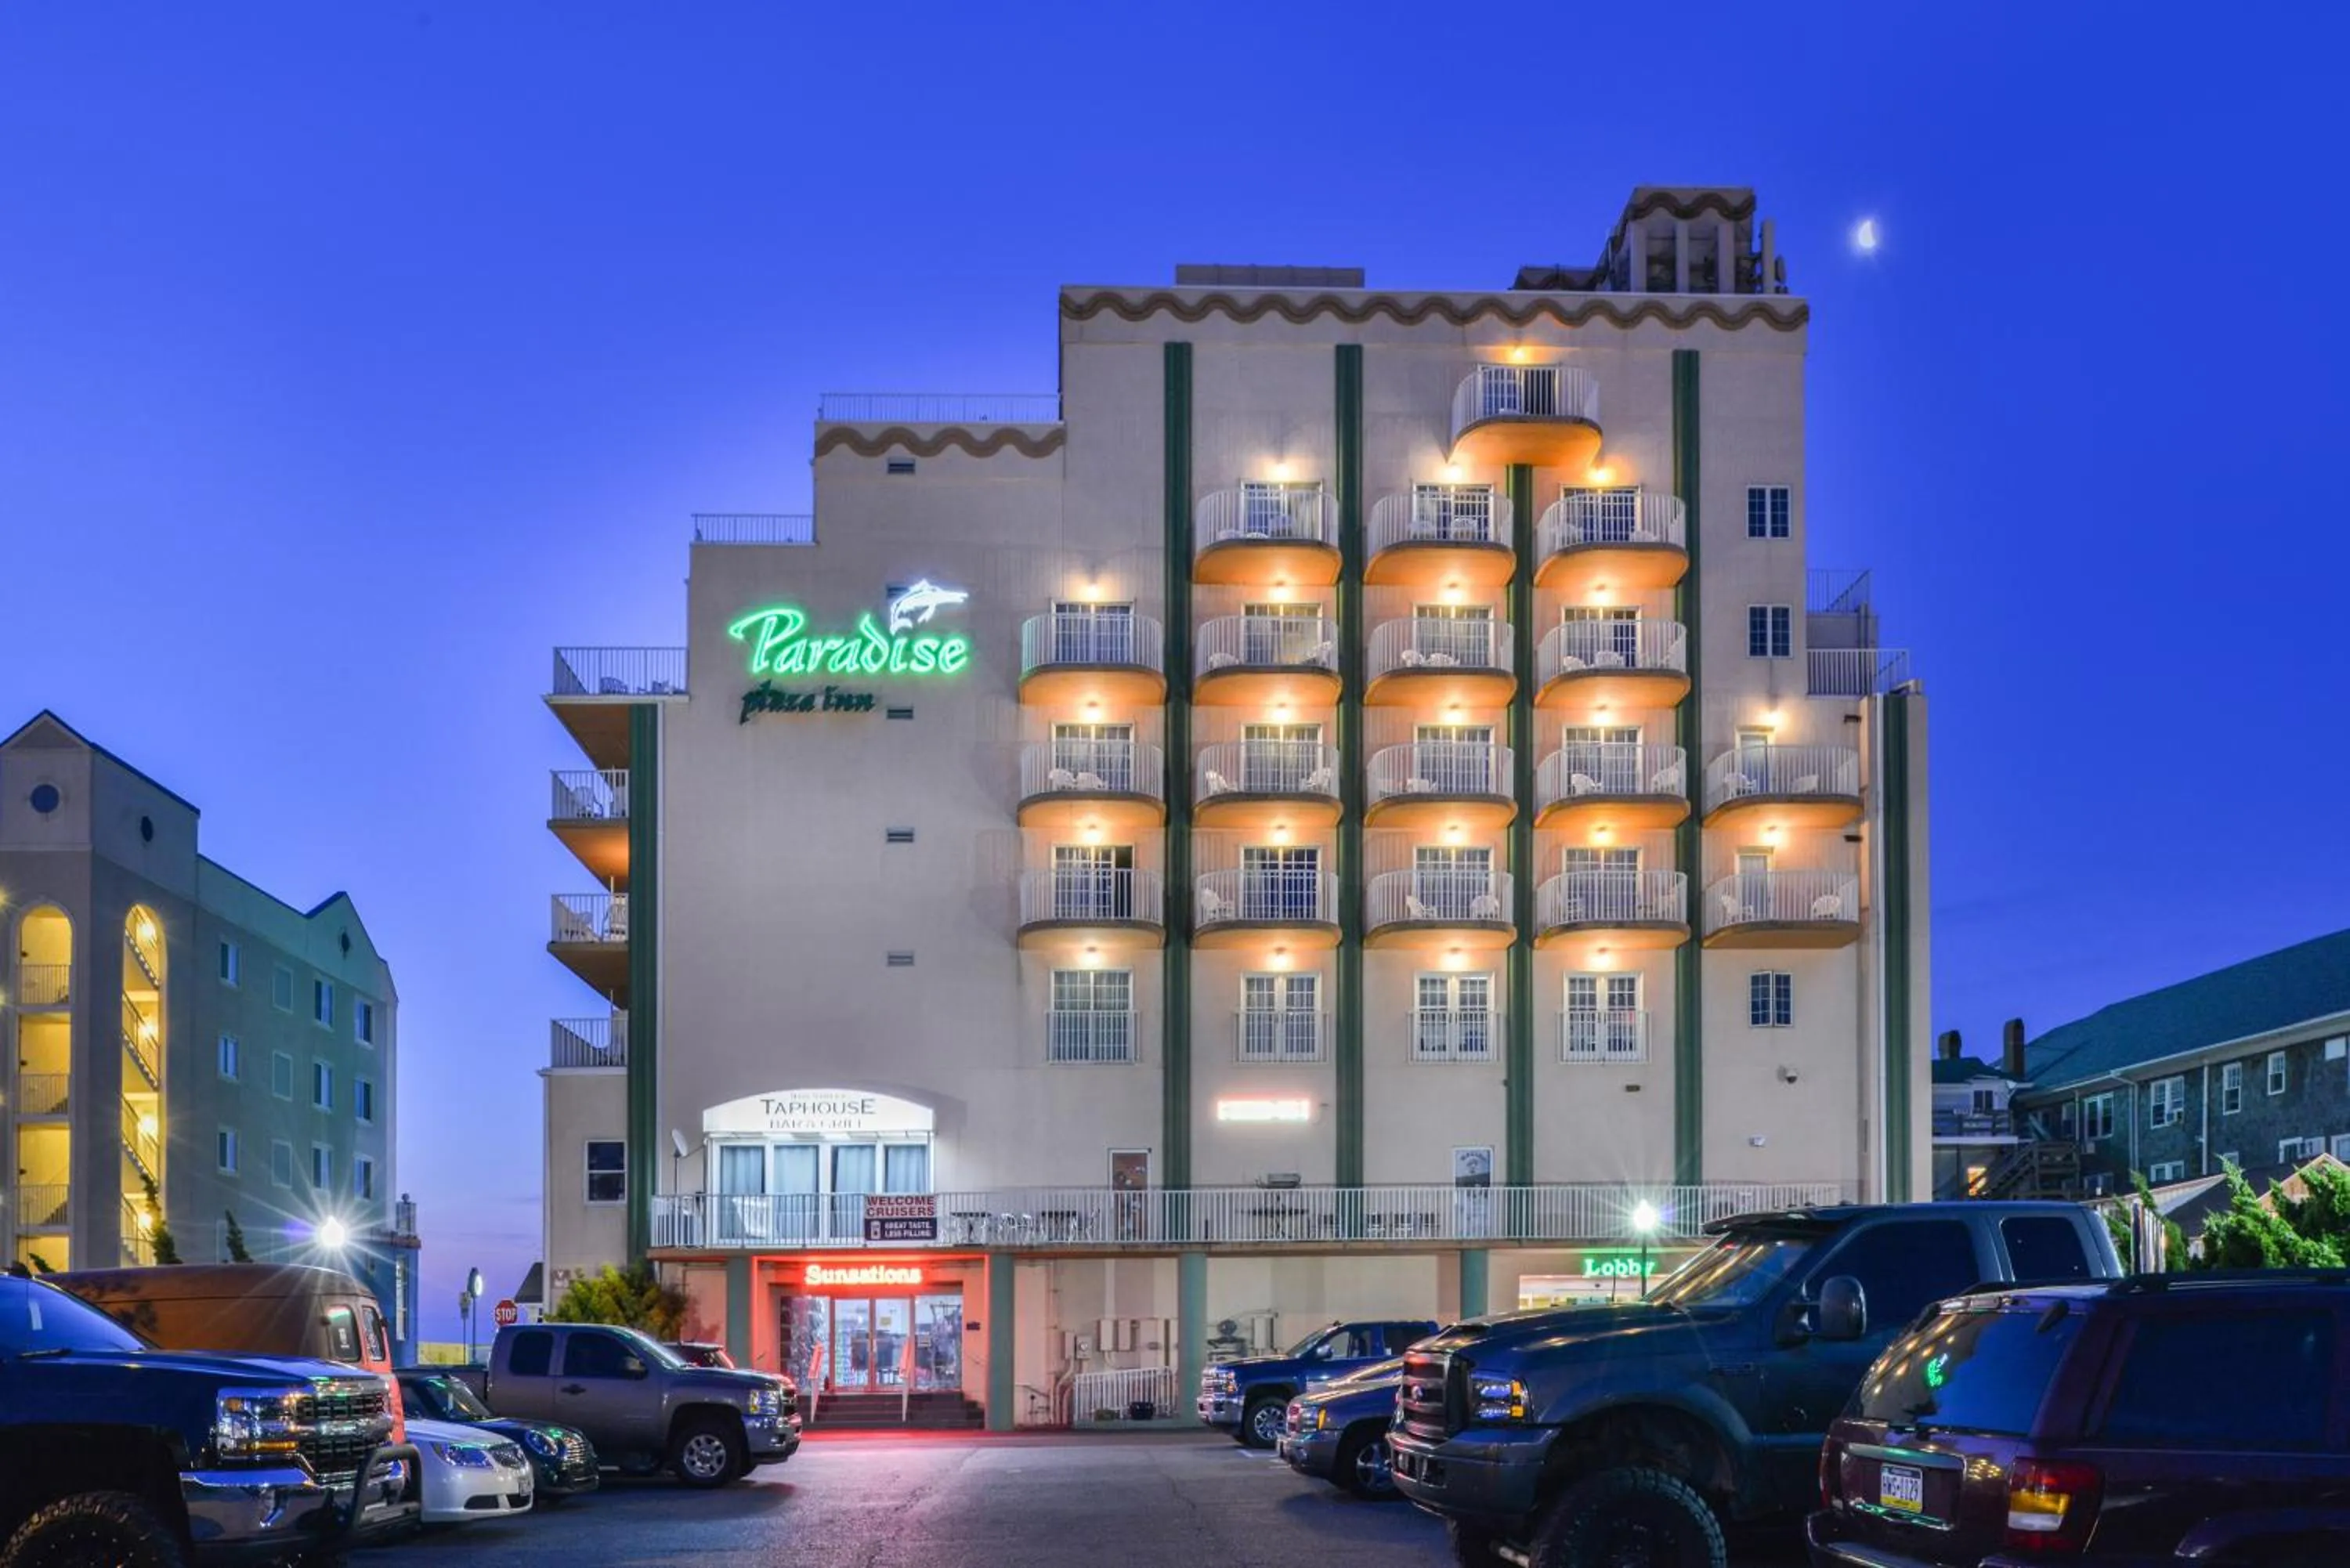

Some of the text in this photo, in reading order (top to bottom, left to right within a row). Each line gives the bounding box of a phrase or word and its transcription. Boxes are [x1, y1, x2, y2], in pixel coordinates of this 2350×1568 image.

[728, 608, 968, 672] Paradise
[760, 1098, 876, 1115] TAPHOUSE
[867, 1196, 934, 1205] WELCOME
[867, 1207, 934, 1216] CRUISERS
[1582, 1258, 1655, 1277] Lobby
[495, 1308, 515, 1321] STOP
